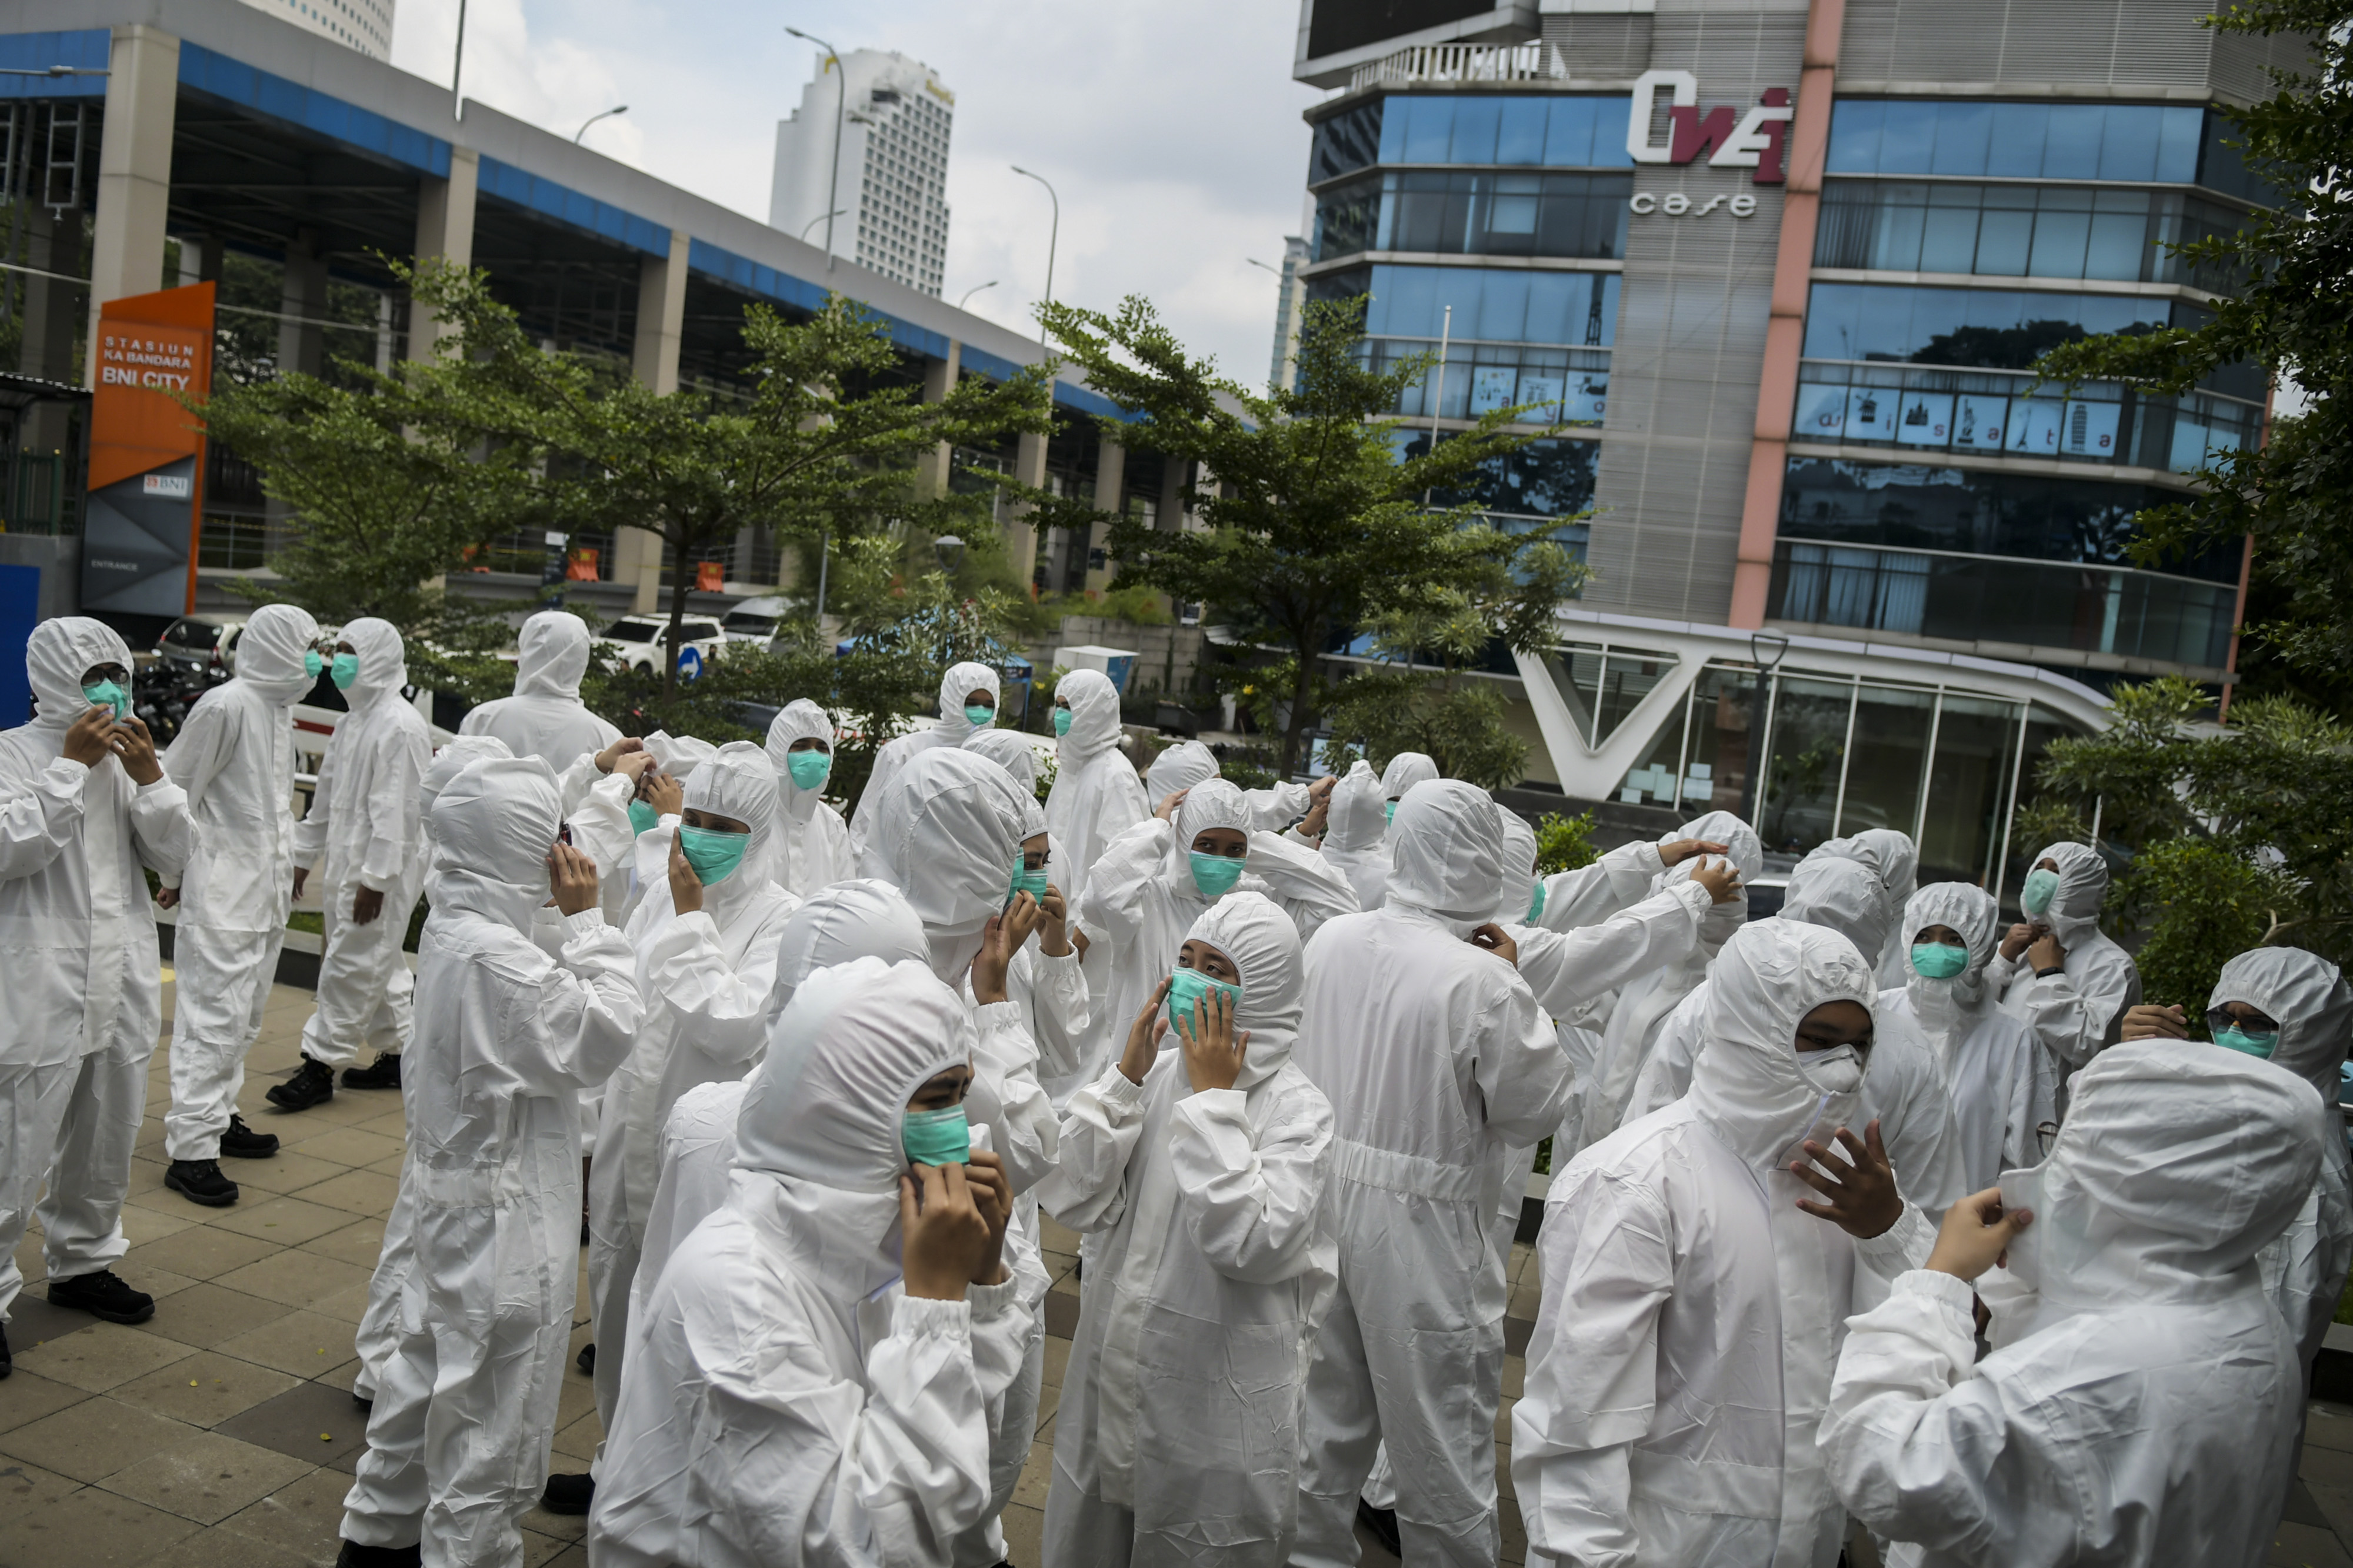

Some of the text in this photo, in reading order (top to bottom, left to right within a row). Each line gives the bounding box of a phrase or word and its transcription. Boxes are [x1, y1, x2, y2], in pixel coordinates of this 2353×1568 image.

[1629, 192, 1758, 218] cafe
[105, 336, 194, 356] STASIUN
[104, 349, 192, 369] KA BANDARA
[102, 366, 191, 392] BNI CITY
[160, 477, 185, 490] BNI
[91, 559, 138, 572] ENTRANCE
